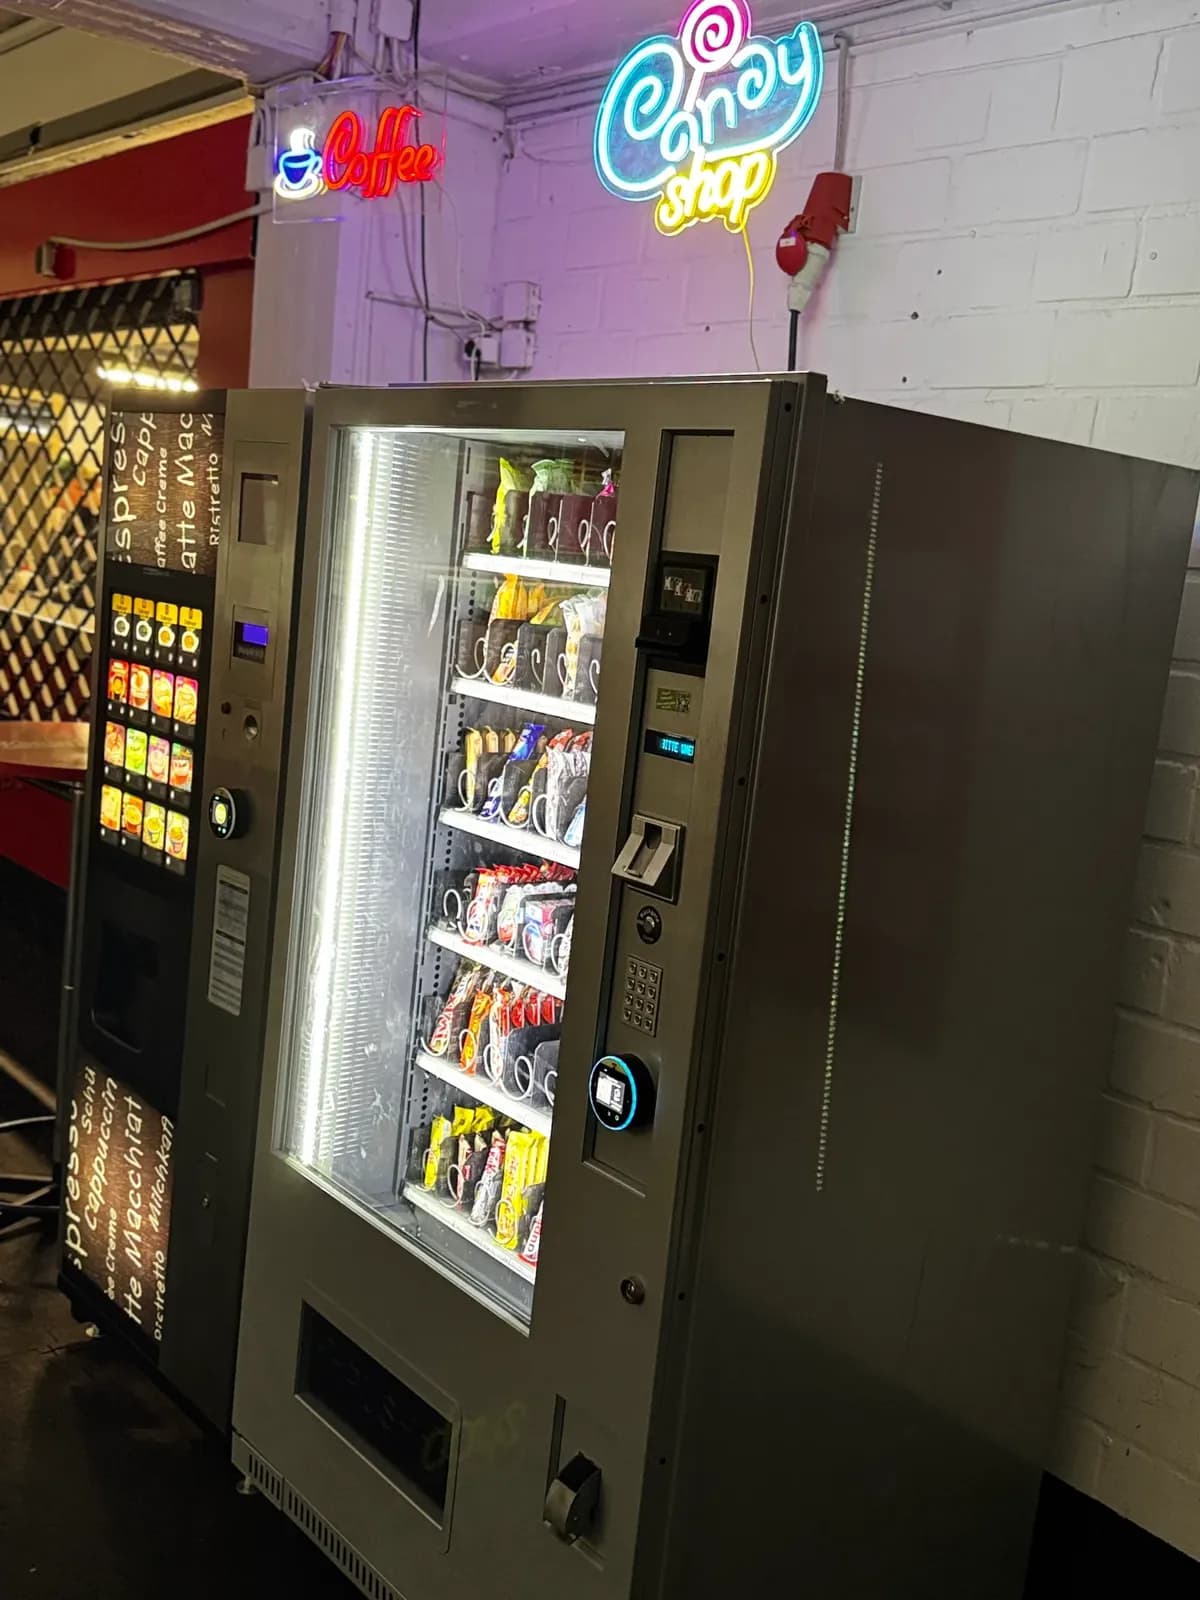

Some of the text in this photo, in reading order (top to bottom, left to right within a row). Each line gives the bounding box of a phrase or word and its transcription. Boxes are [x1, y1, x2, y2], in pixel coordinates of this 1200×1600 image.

[322, 105, 441, 198] Coffee
[596, 21, 819, 198] Candy
[656, 150, 774, 235] shop
[175, 500, 197, 574] atte
[84, 1077, 118, 1230] Cappuccin
[123, 1095, 143, 1270] Macchiat
